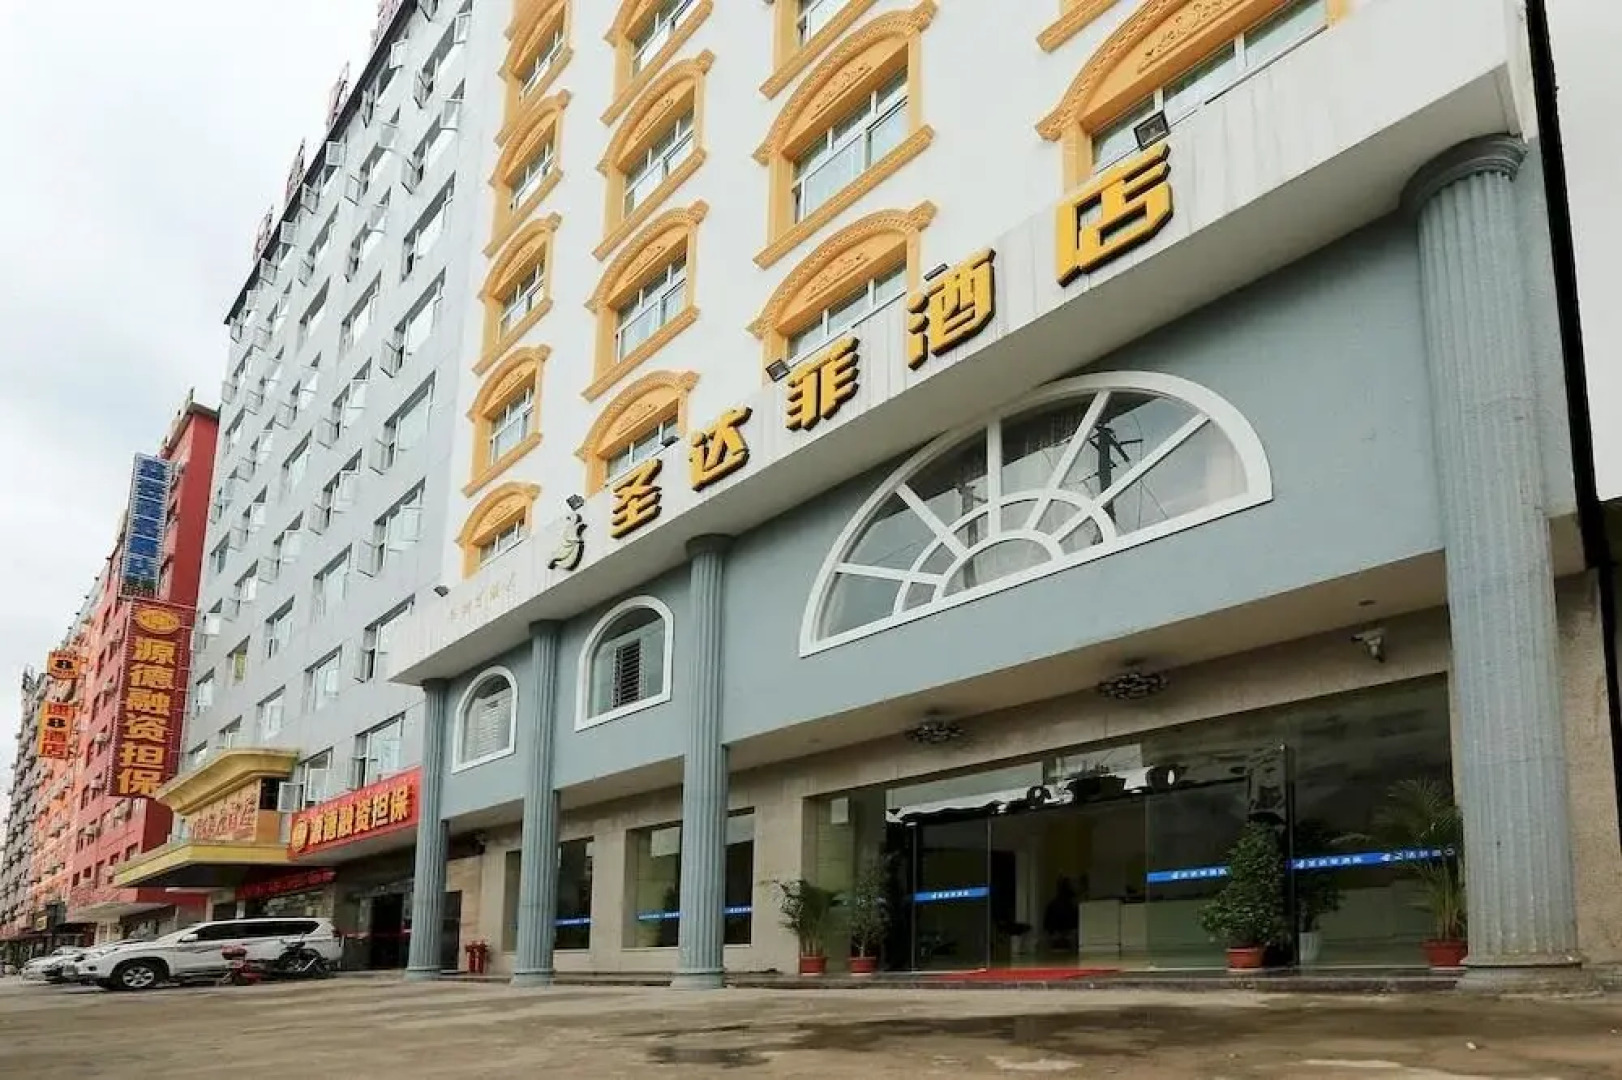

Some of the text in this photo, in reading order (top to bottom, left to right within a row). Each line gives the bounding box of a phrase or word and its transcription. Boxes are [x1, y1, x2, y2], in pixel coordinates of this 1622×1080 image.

[610, 142, 1173, 538] 圣达菲酒店
[117, 637, 175, 795] 源德融资担保
